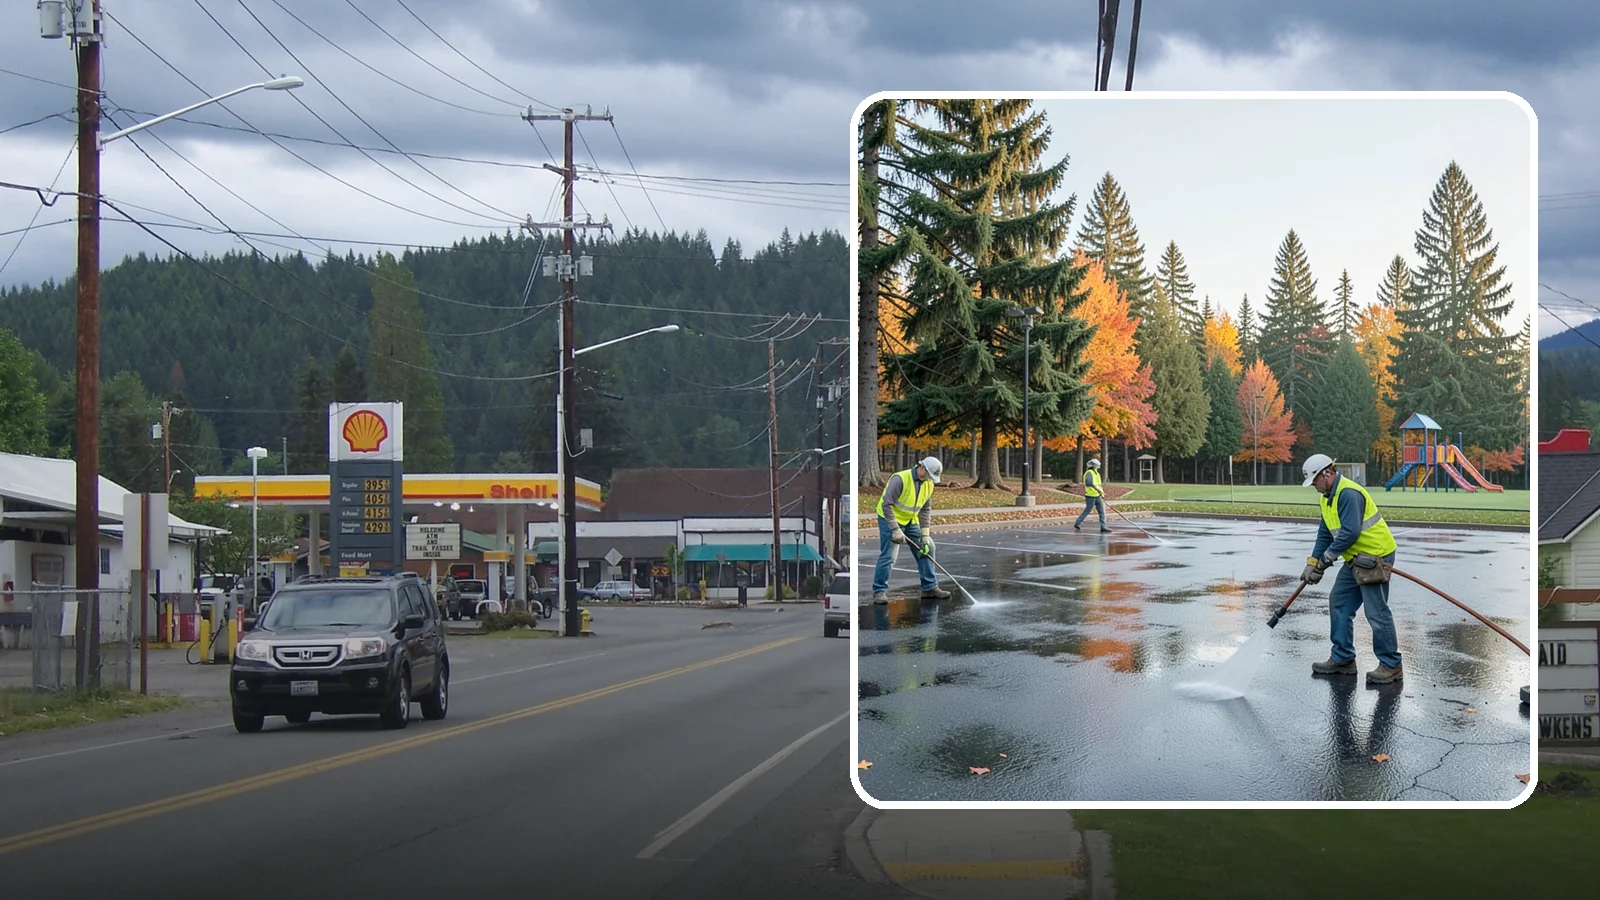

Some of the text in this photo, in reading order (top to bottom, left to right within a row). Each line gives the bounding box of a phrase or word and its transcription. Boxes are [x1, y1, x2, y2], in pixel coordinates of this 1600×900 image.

[366, 480, 383, 490] 395
[490, 484, 548, 499] Shell
[366, 494, 383, 504] 405
[366, 508, 383, 518] 415
[366, 522, 383, 532] 429
[1538, 643, 1567, 665] AID
